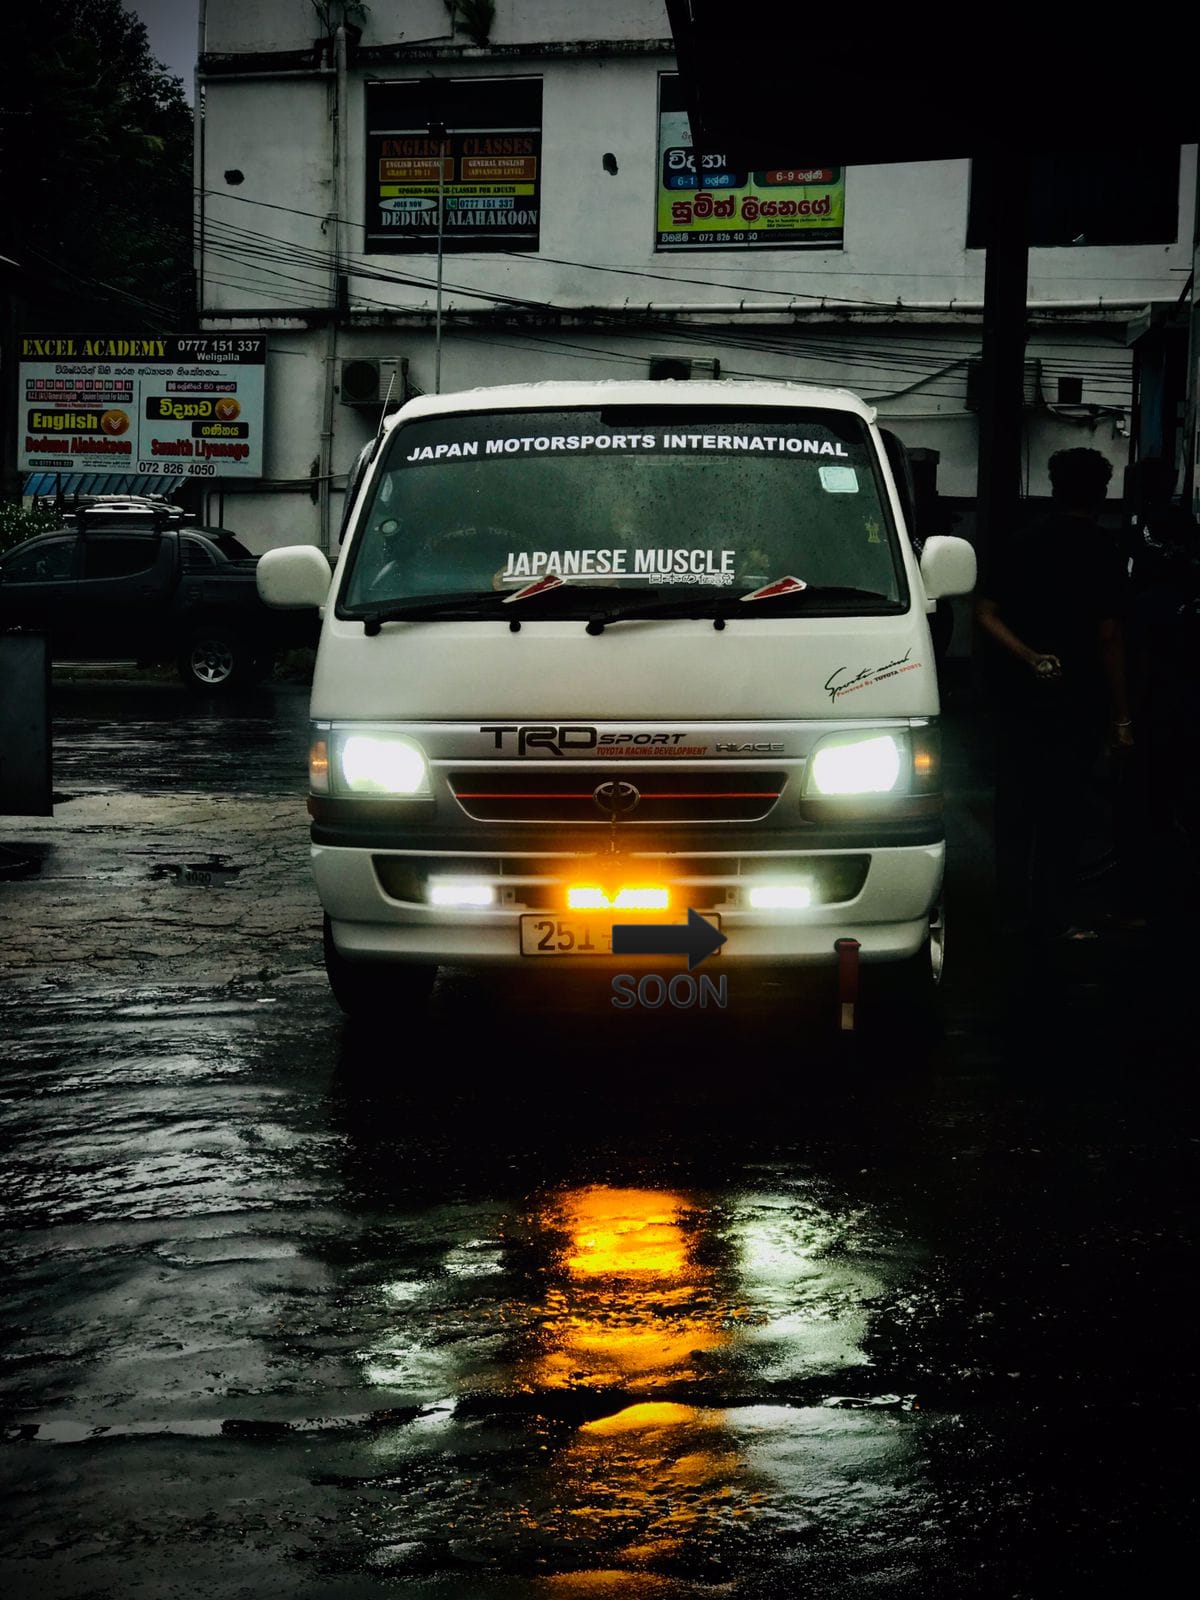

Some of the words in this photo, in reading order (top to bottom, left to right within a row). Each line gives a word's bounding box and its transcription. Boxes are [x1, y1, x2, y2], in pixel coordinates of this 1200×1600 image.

[382, 139, 453, 156] ENGLISH
[463, 138, 533, 155] CLASSES
[776, 171, 795, 181] 6-9
[460, 200, 478, 208] 0777
[381, 211, 440, 226] DEDUNU
[446, 210, 538, 226] ALAHAKOON
[699, 233, 712, 241] 072
[716, 233, 731, 241] 826
[734, 232, 745, 240] 40
[22, 339, 77, 356] EXCEL
[81, 339, 168, 357] ACADEMY
[177, 340, 208, 352] 0777
[212, 340, 233, 352] 151
[237, 340, 261, 352] 337
[197, 352, 240, 363] Weligalla
[32, 413, 98, 430] English
[195, 439, 249, 460] Liyanage
[407, 441, 479, 461] JAPAN
[485, 435, 656, 454] MOTORSPORTS
[663, 434, 848, 457] INTERNATIONAL
[139, 462, 159, 473] 072
[163, 463, 183, 475] 826
[187, 464, 215, 476] 4050
[502, 550, 627, 577] JAPANESE
[634, 549, 736, 574] MUSCLE
[874, 670, 899, 682] TOYOTA
[480, 726, 597, 756] TRD
[598, 734, 688, 745] SPORT
[596, 746, 626, 756] TOYOTA
[627, 746, 652, 756] RACING
[653, 746, 708, 756] DEVELOPMENT
